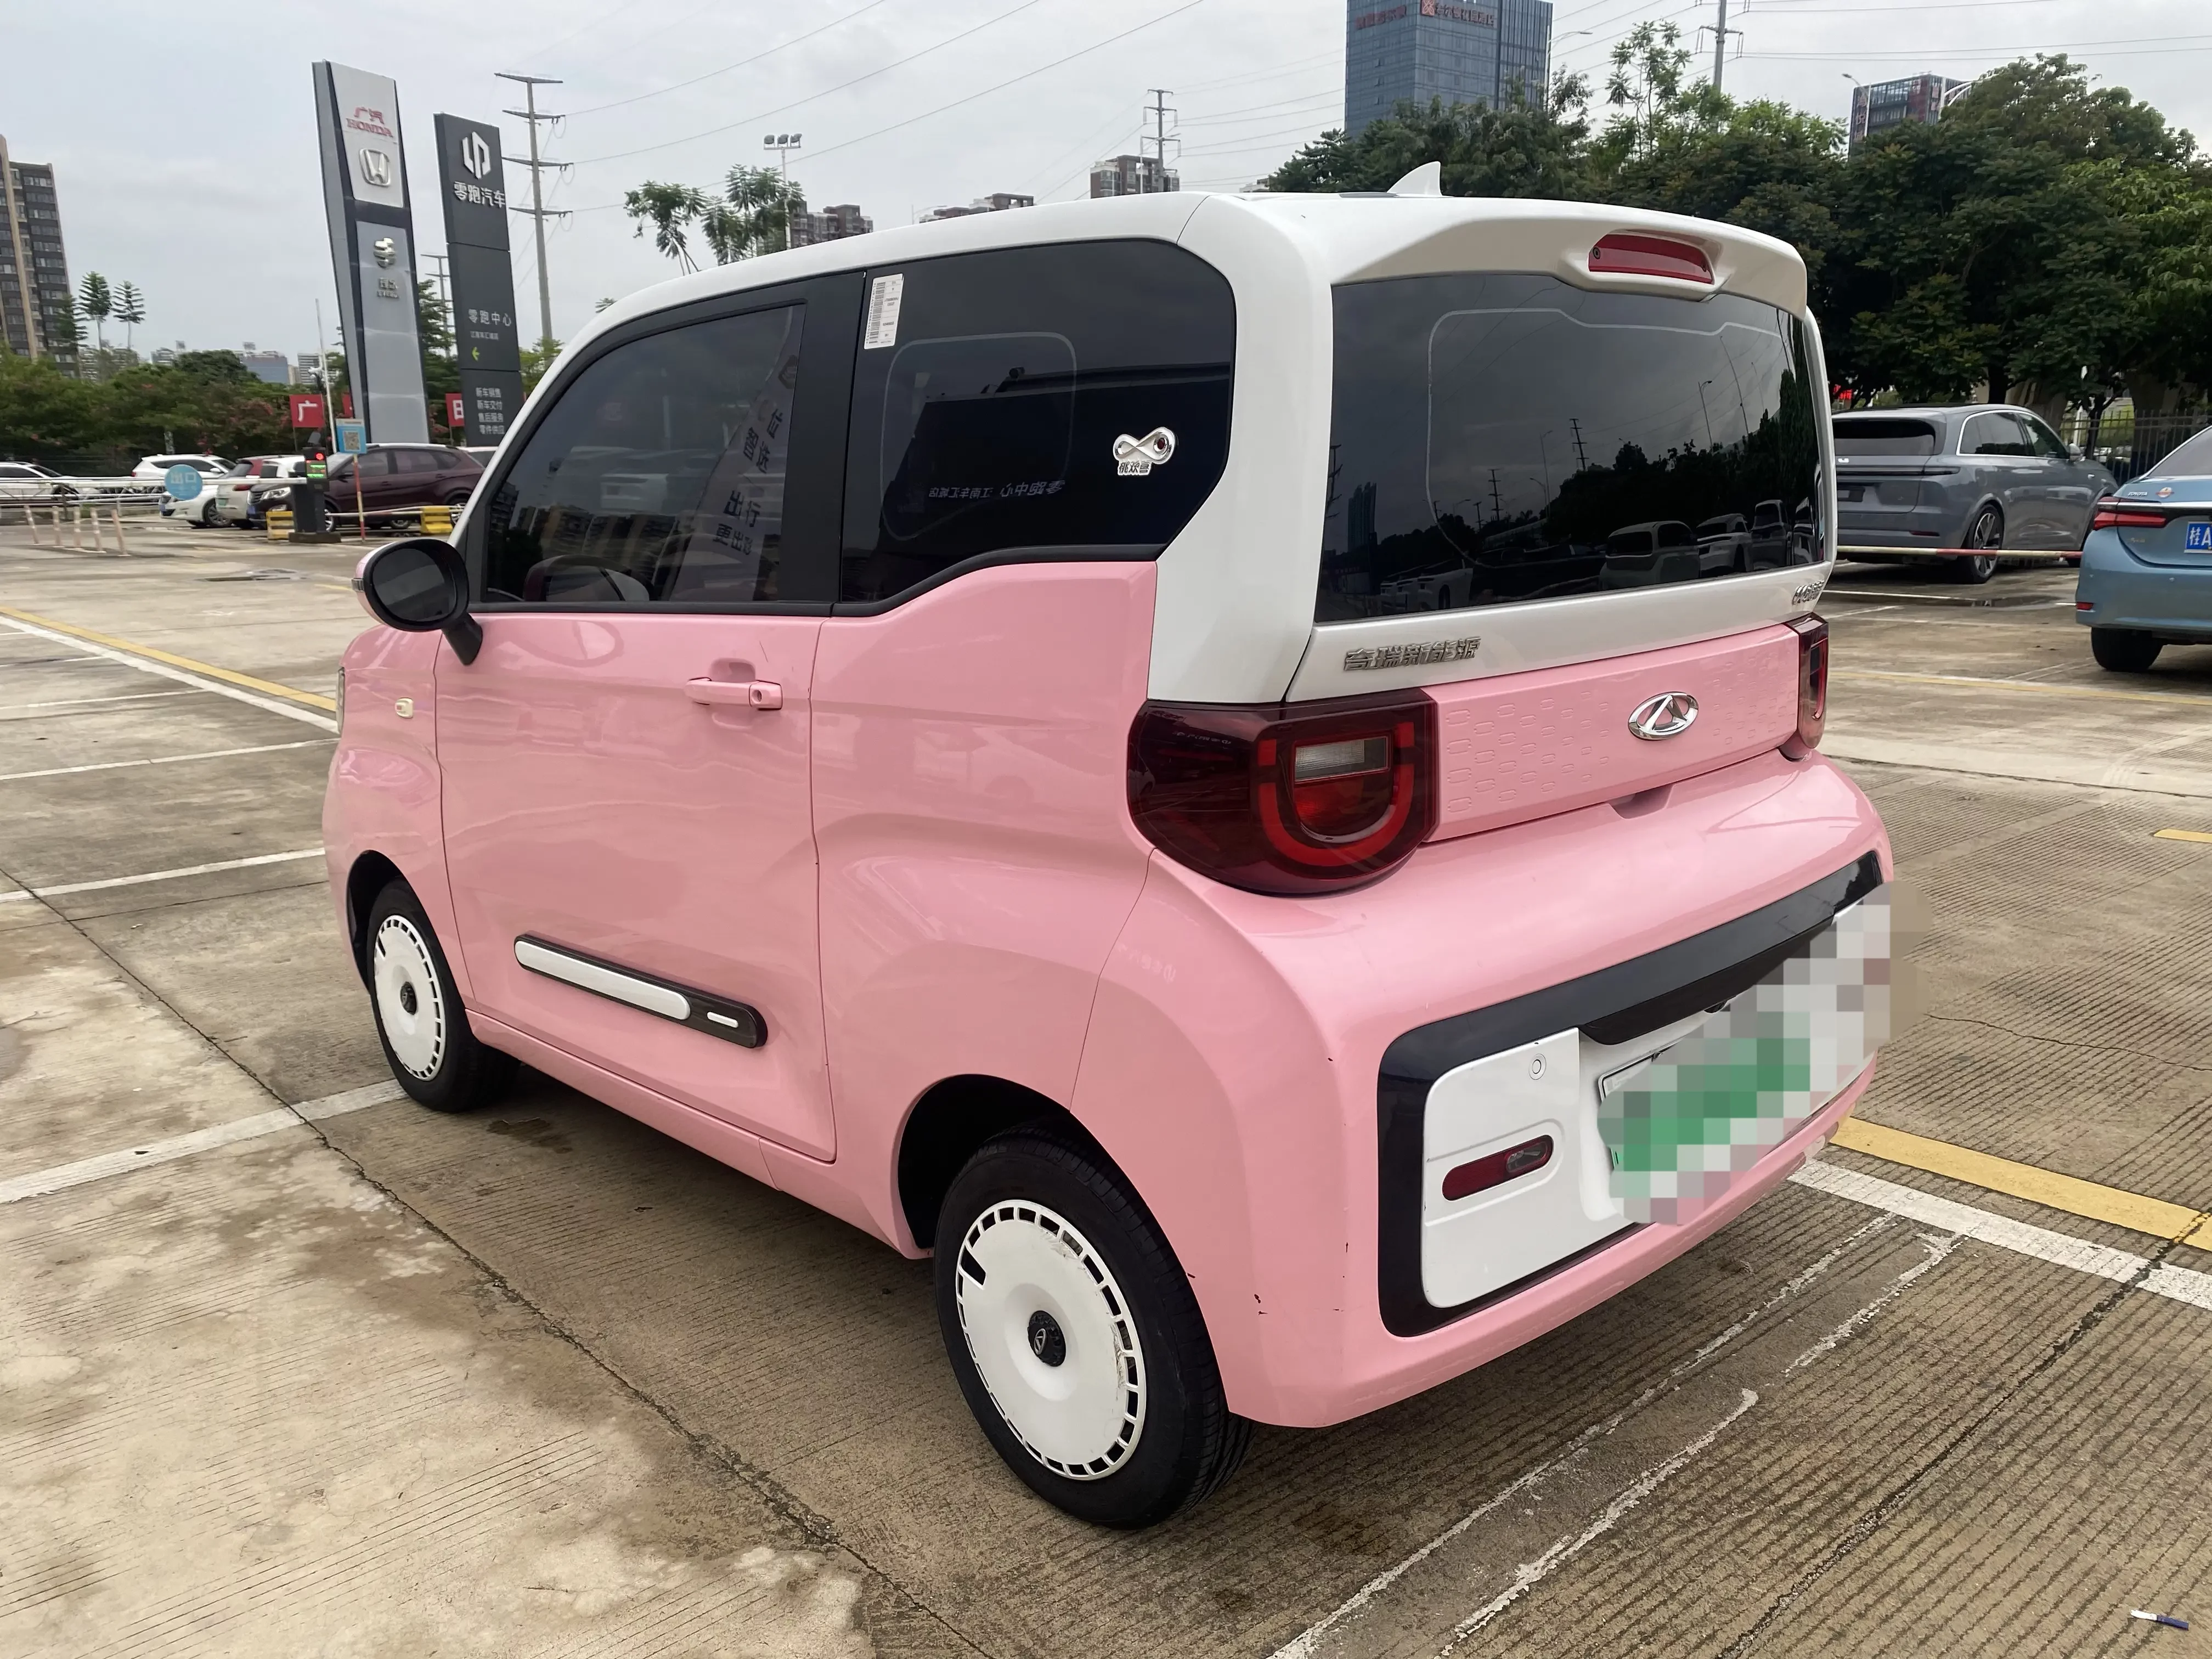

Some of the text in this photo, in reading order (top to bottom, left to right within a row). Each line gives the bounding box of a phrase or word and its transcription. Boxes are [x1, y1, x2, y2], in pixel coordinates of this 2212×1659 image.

[354, 106, 385, 125] 广汽
[346, 117, 393, 138] HONDA
[454, 180, 505, 208] 零跑汽车
[468, 308, 512, 326] 零跑中心
[298, 400, 318, 422] 广
[171, 472, 197, 484] 出口
[1344, 636, 1482, 672] 奇瑞新能源
